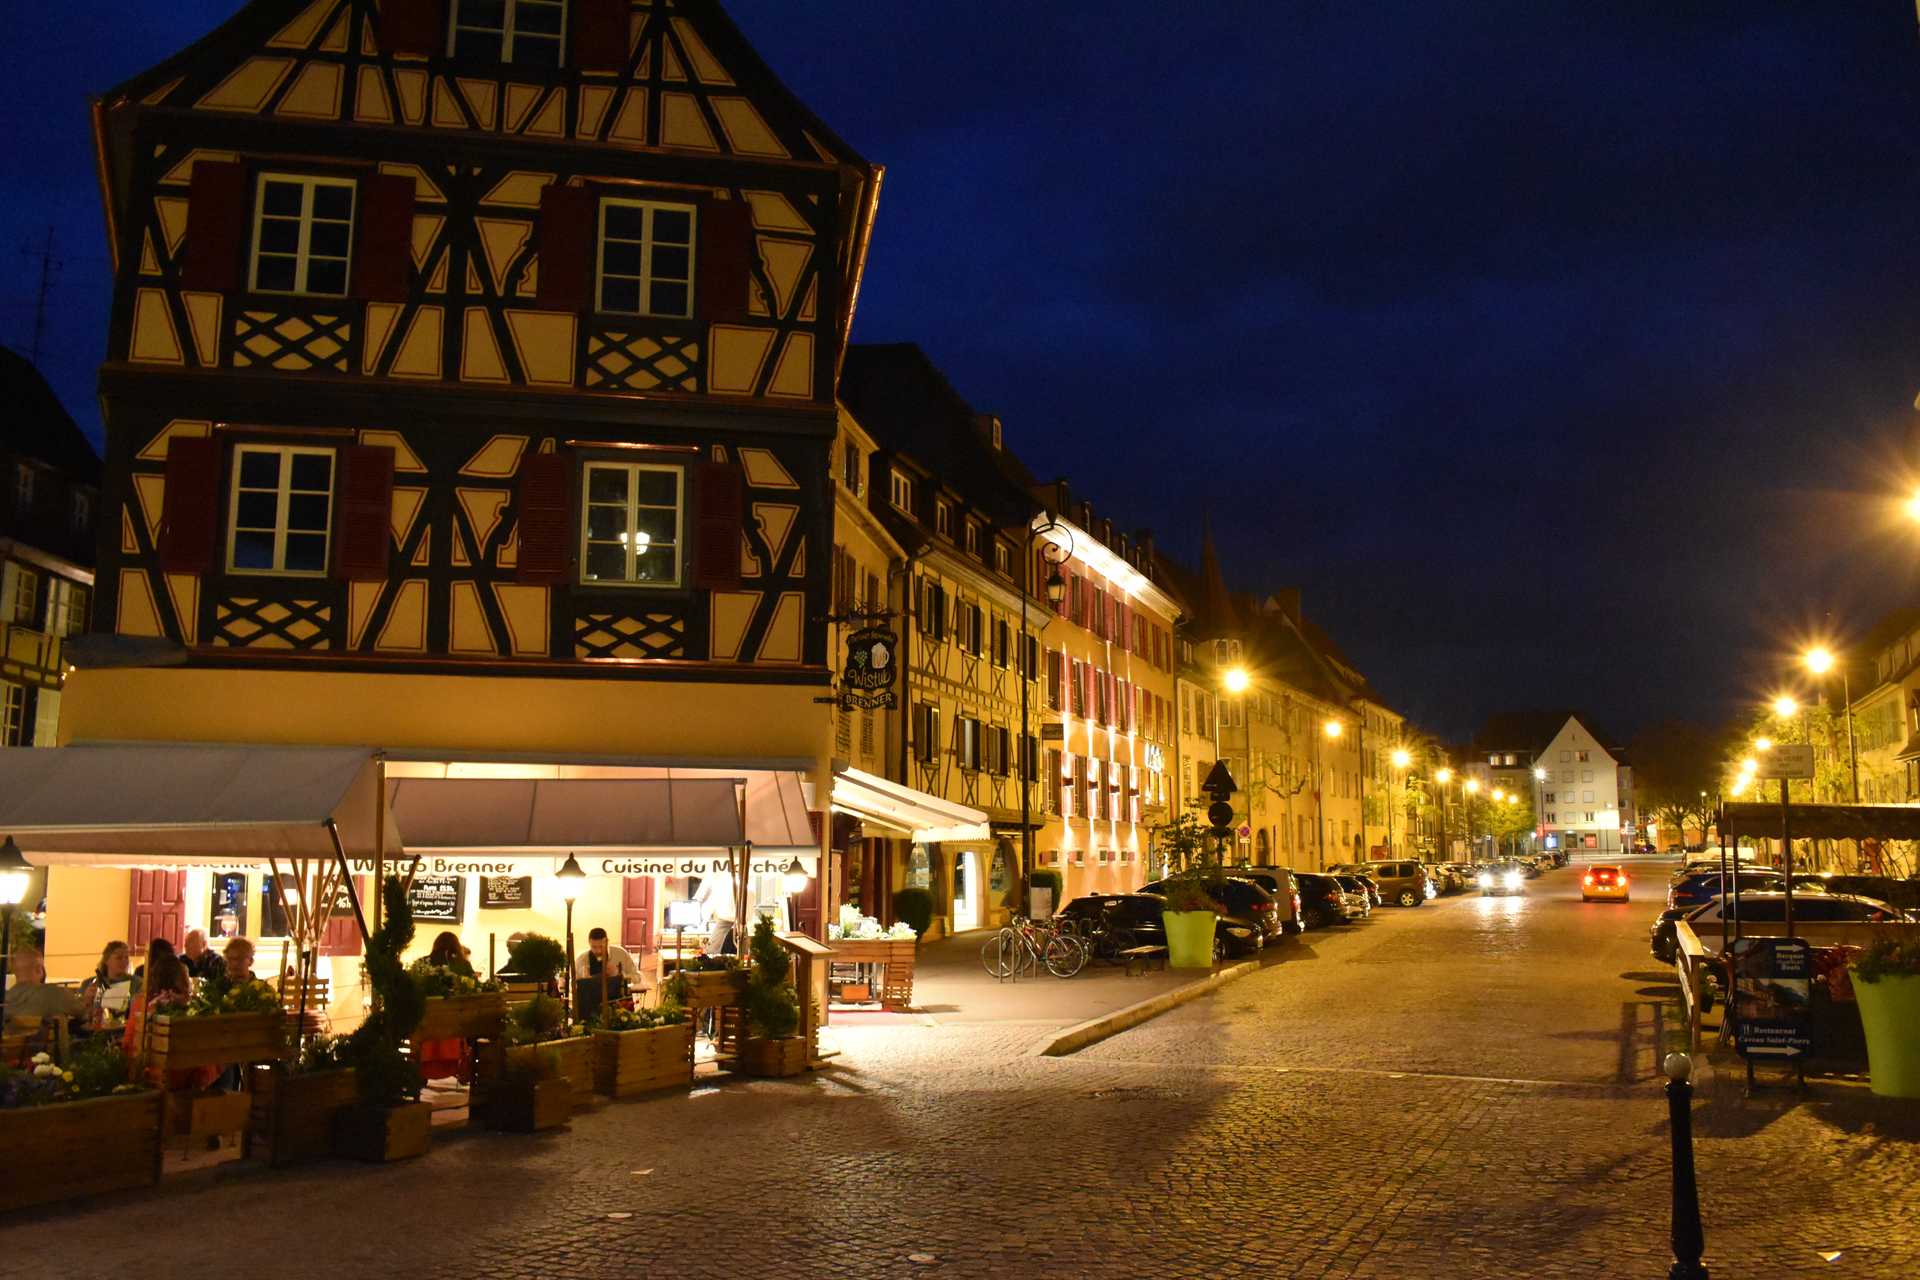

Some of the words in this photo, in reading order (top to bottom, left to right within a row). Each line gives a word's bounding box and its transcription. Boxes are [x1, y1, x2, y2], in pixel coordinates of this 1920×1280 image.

[846, 693, 892, 708] BRENNER
[353, 858, 427, 872] Wstub
[434, 858, 515, 873] Brenner
[601, 858, 674, 874] Cuisine
[680, 859, 706, 874] du
[712, 858, 790, 873] Mché
